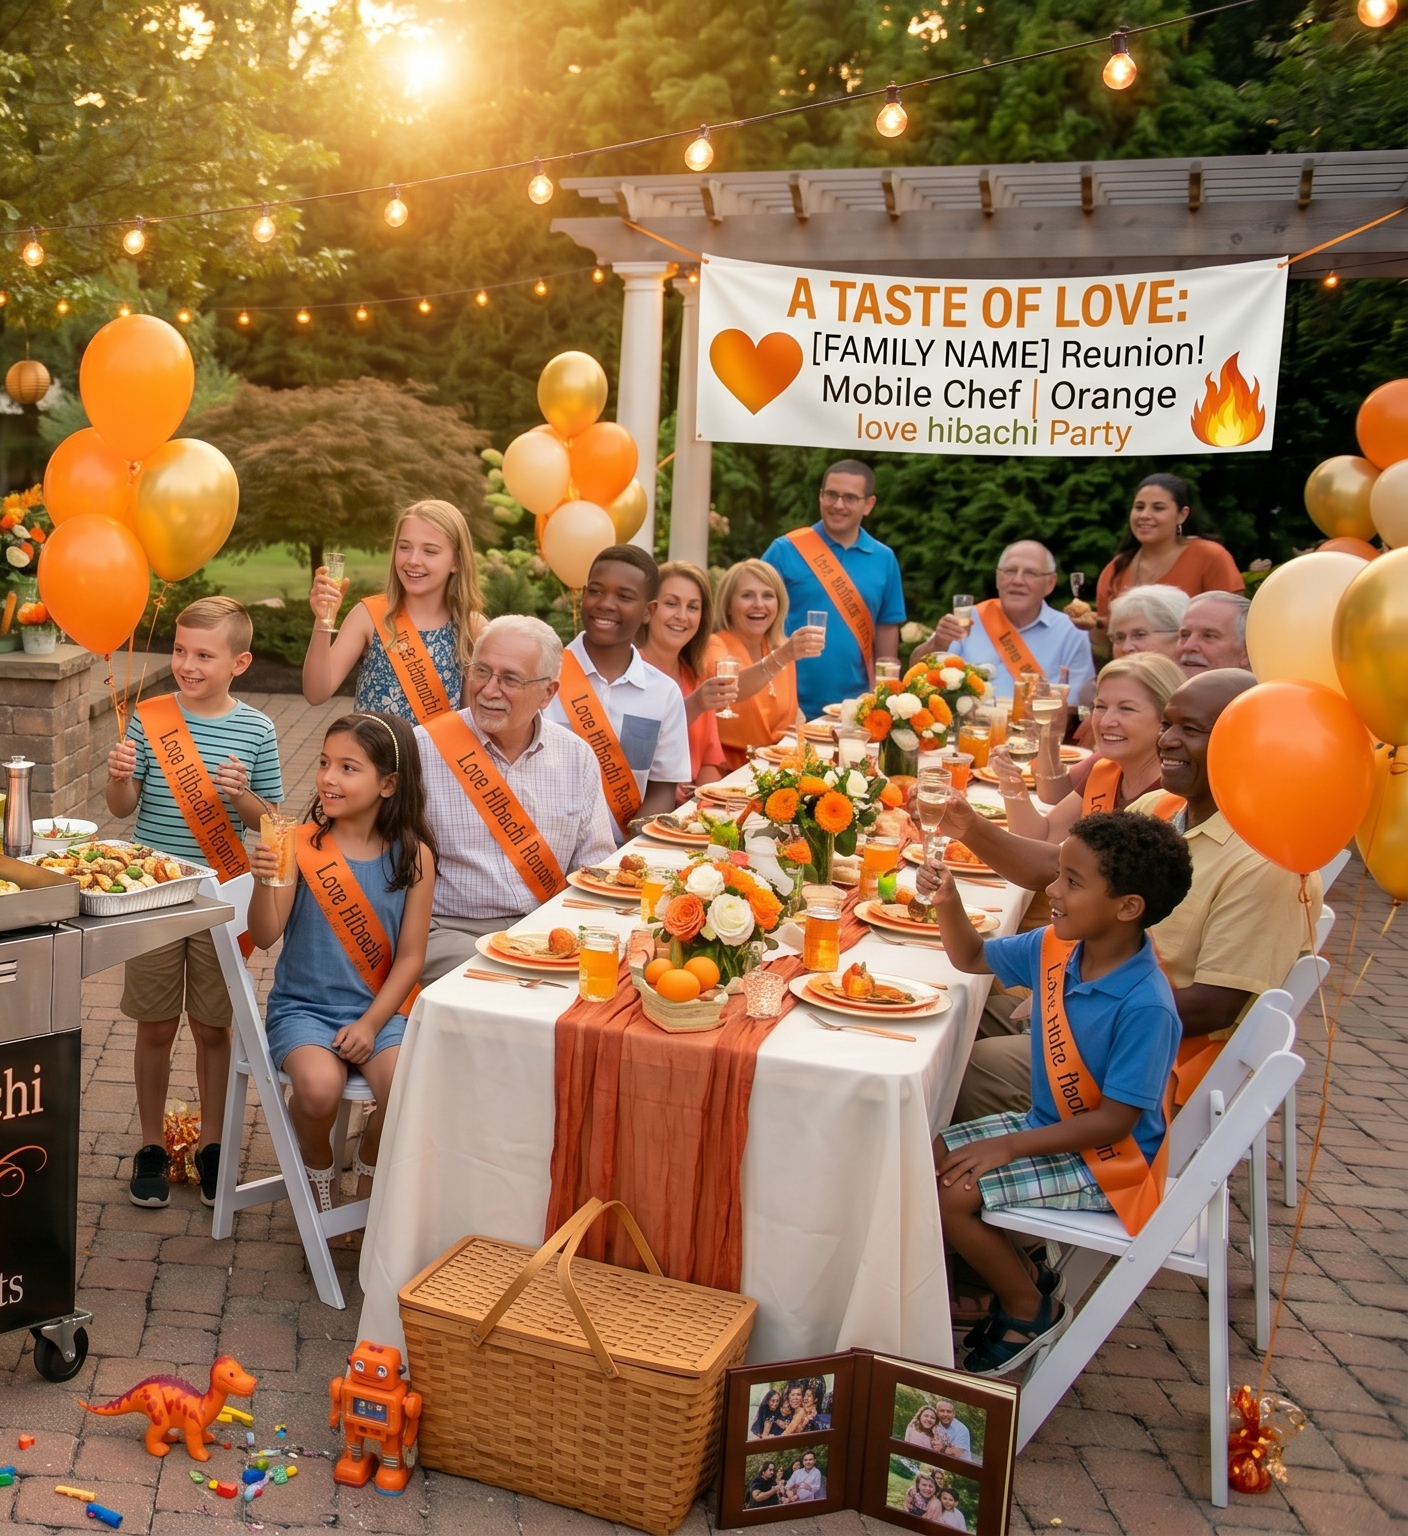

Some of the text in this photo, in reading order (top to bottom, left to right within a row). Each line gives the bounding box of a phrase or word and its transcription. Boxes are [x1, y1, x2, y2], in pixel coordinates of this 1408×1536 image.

[787, 276, 1188, 329] A TASTE OF LOVE:
[812, 331, 1205, 374] [FAMILY NAME] Reunion!
[822, 374, 932, 408] Mobile
[943, 379, 1021, 411] Chef
[1050, 380, 1177, 416] Orange
[857, 413, 1132, 453] love hibachi Party
[316, 861, 347, 906] Love
